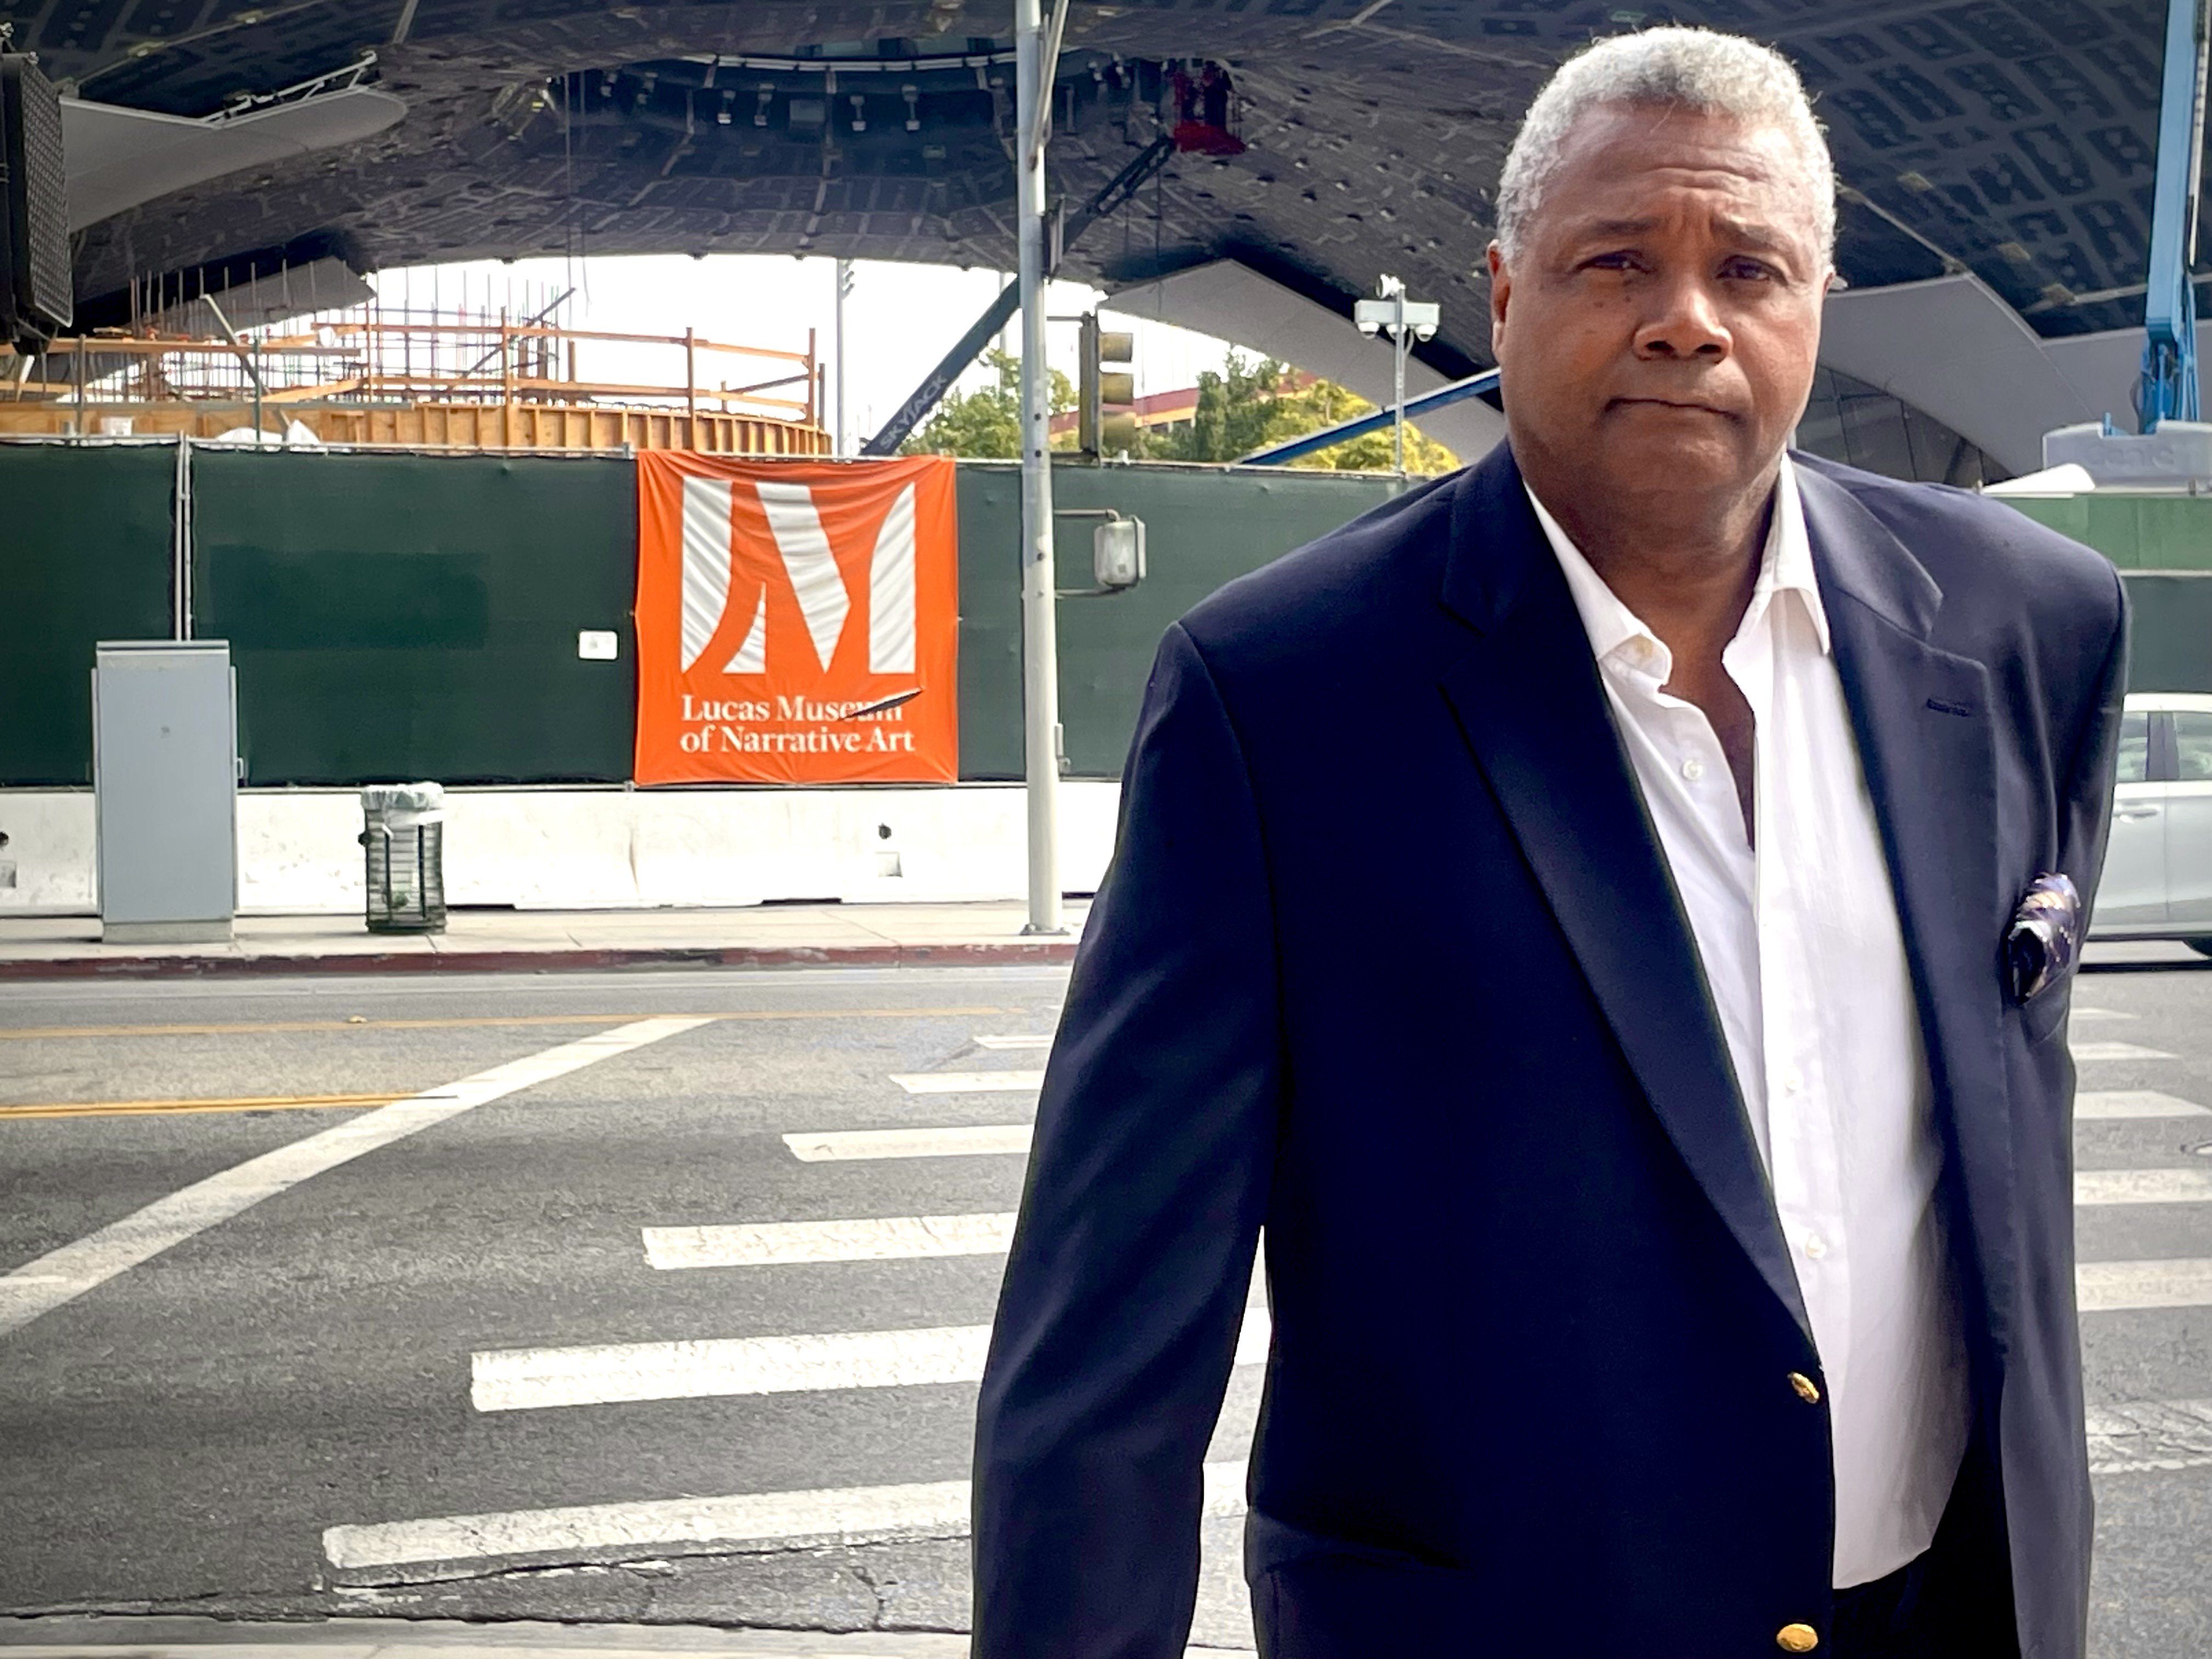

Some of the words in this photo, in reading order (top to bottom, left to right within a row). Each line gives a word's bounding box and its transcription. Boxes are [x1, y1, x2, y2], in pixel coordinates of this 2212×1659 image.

[880, 375, 947, 449] SKYJACK
[681, 695, 771, 721] Lucas
[680, 725, 716, 753] of
[721, 726, 861, 753] Narrative
[865, 726, 916, 752] Art
